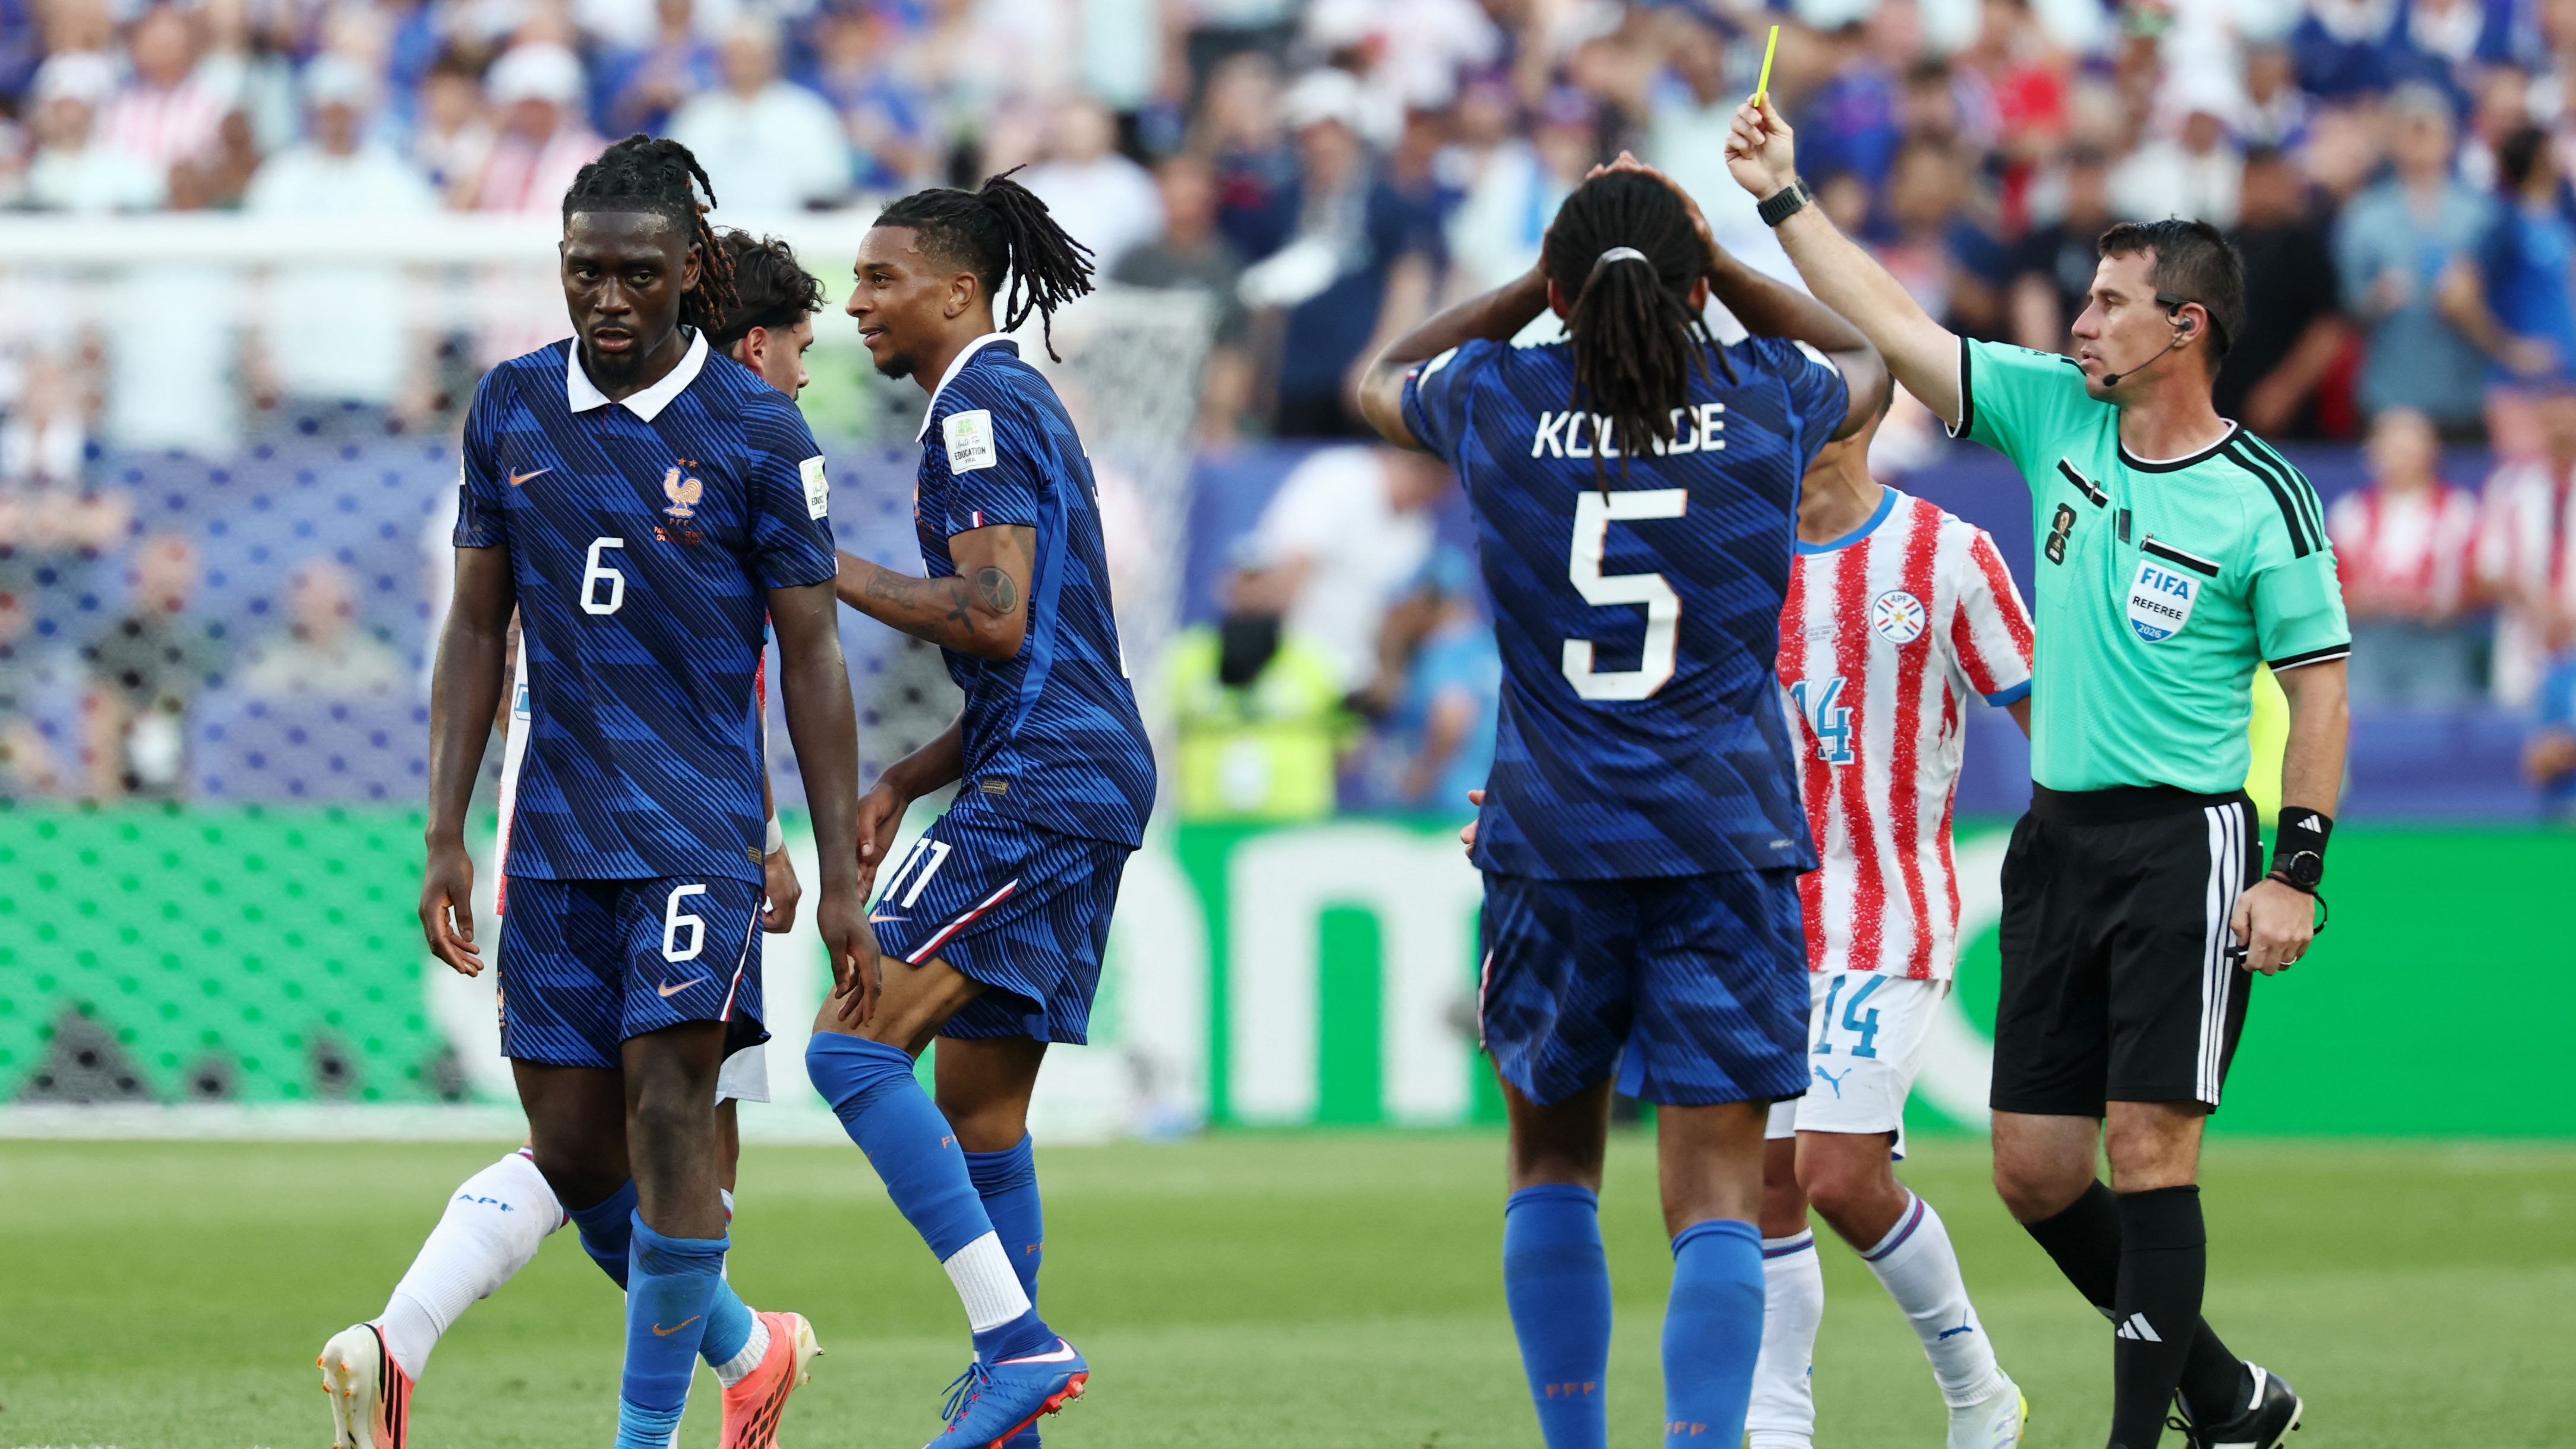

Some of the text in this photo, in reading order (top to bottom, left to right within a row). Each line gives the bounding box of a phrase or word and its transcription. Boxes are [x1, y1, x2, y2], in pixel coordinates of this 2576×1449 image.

[1531, 403, 1726, 458] KOUDE
[954, 446, 986, 460] EDUCATION
[580, 536, 625, 615] 6
[1562, 488, 1688, 700] 5
[2141, 567, 2189, 600] FIFA
[1890, 595, 1908, 603] APF
[2132, 596, 2183, 620] REFEREE
[2137, 623, 2163, 639] 2026
[1788, 676, 1855, 766] 14
[662, 883, 706, 962] 6
[1812, 973, 1889, 1059] 14
[456, 1194, 514, 1212] APF
